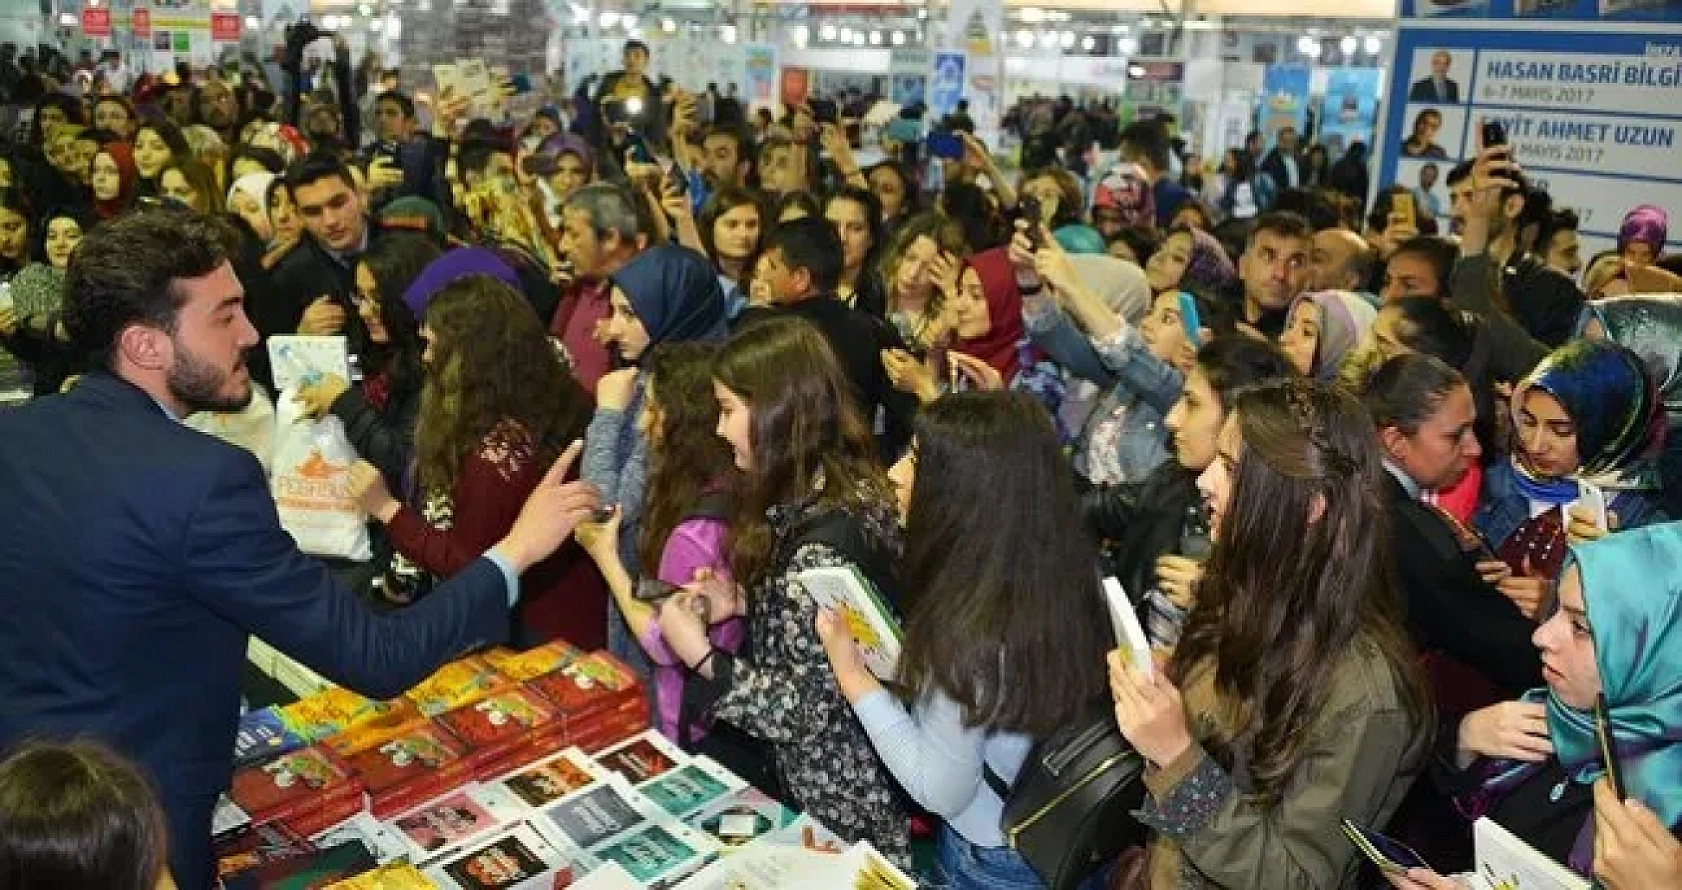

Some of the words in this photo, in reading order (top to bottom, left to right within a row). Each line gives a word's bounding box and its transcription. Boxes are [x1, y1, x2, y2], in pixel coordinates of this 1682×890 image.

[1487, 60, 1555, 81] HASAN
[1558, 60, 1620, 85] BASRİ
[1511, 86, 1553, 101] MAYIS
[1555, 88, 1595, 103] 2017
[1536, 119, 1612, 143] AHMET
[1614, 126, 1675, 147] UZUN
[1520, 143, 1561, 161] MAYIS
[1564, 147, 1606, 164] 2017
